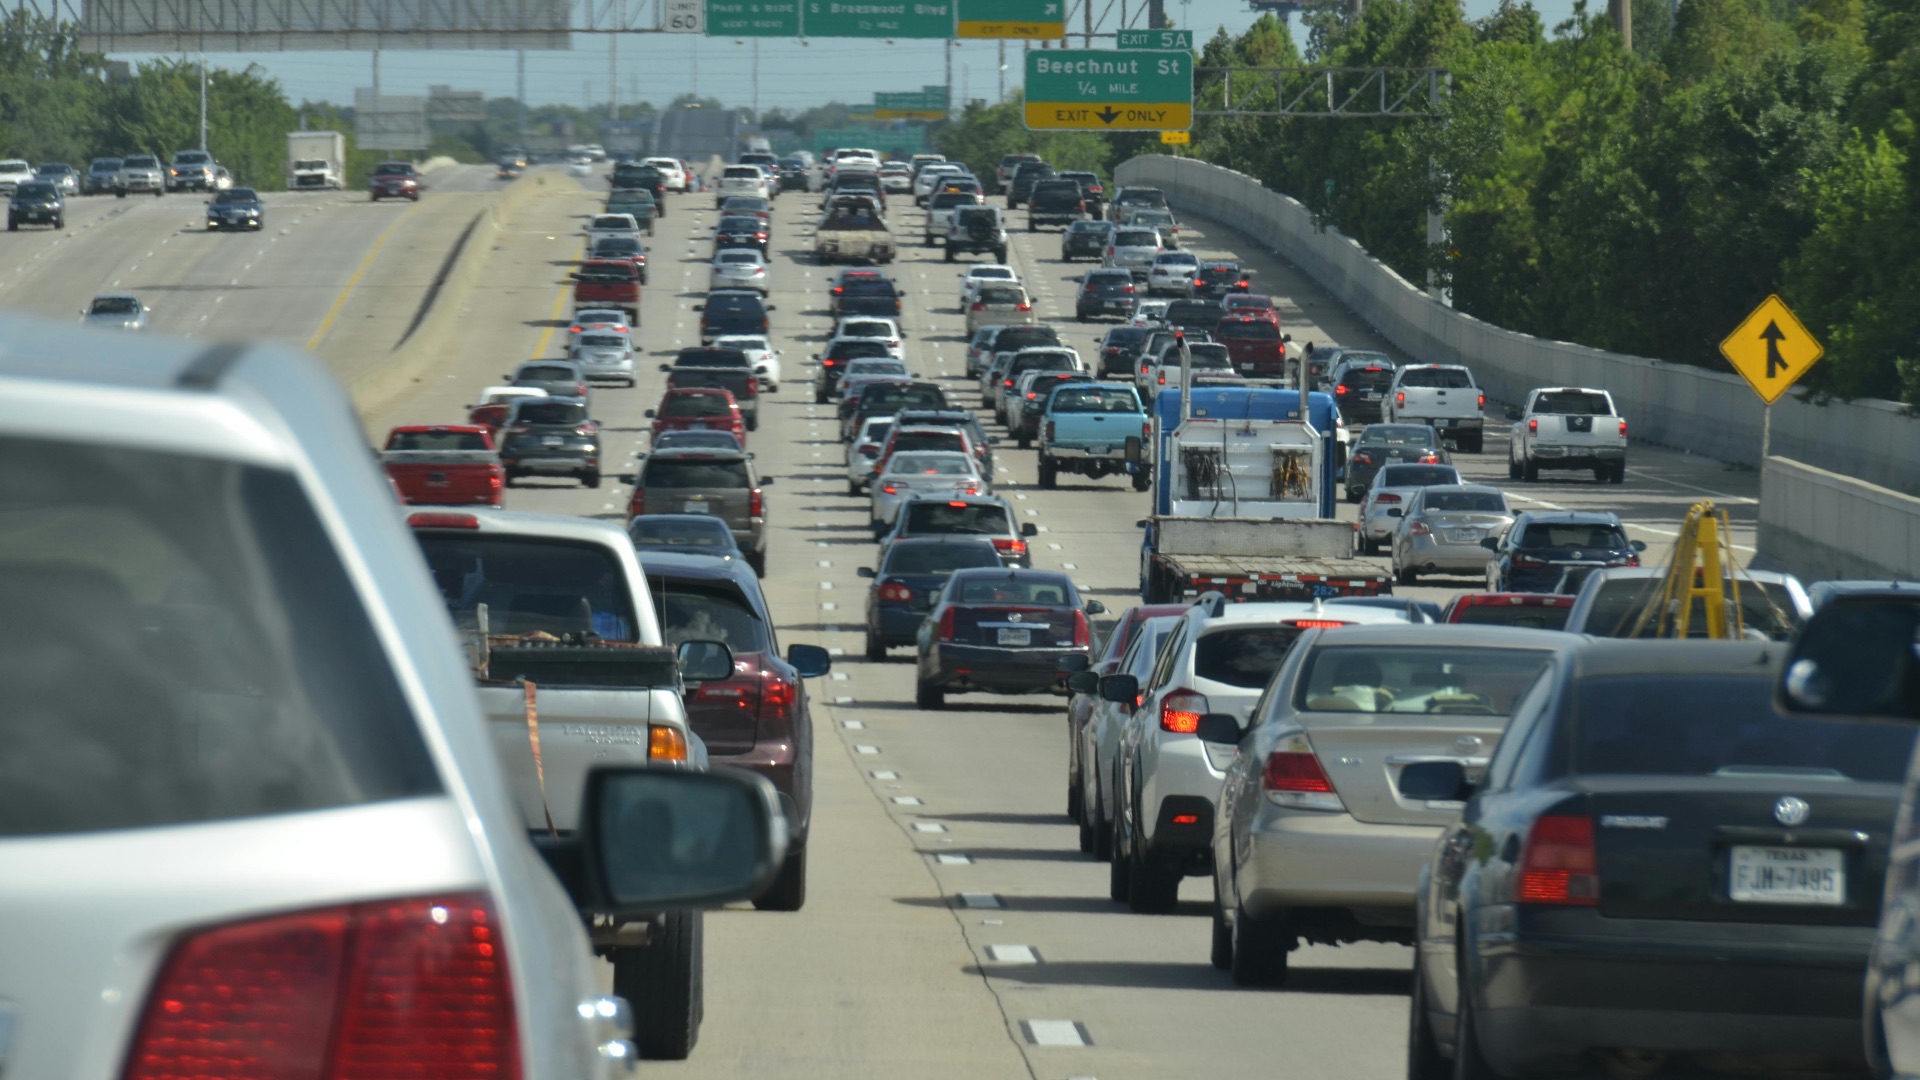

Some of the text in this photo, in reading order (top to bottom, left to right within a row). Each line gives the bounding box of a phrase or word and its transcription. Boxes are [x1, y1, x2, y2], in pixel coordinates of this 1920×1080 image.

[765, 4, 794, 13] RIDE
[810, 3, 820, 14] S
[671, 14, 697, 29] 60
[1121, 32, 1188, 48] EXIT 5A
[1037, 58, 1180, 75] Beechnut St
[1108, 83, 1139, 94] MILE
[1055, 110, 1167, 122] EXIT ONLY
[1312, 585, 1334, 596] 282
[1765, 850, 1808, 861] TEXAS
